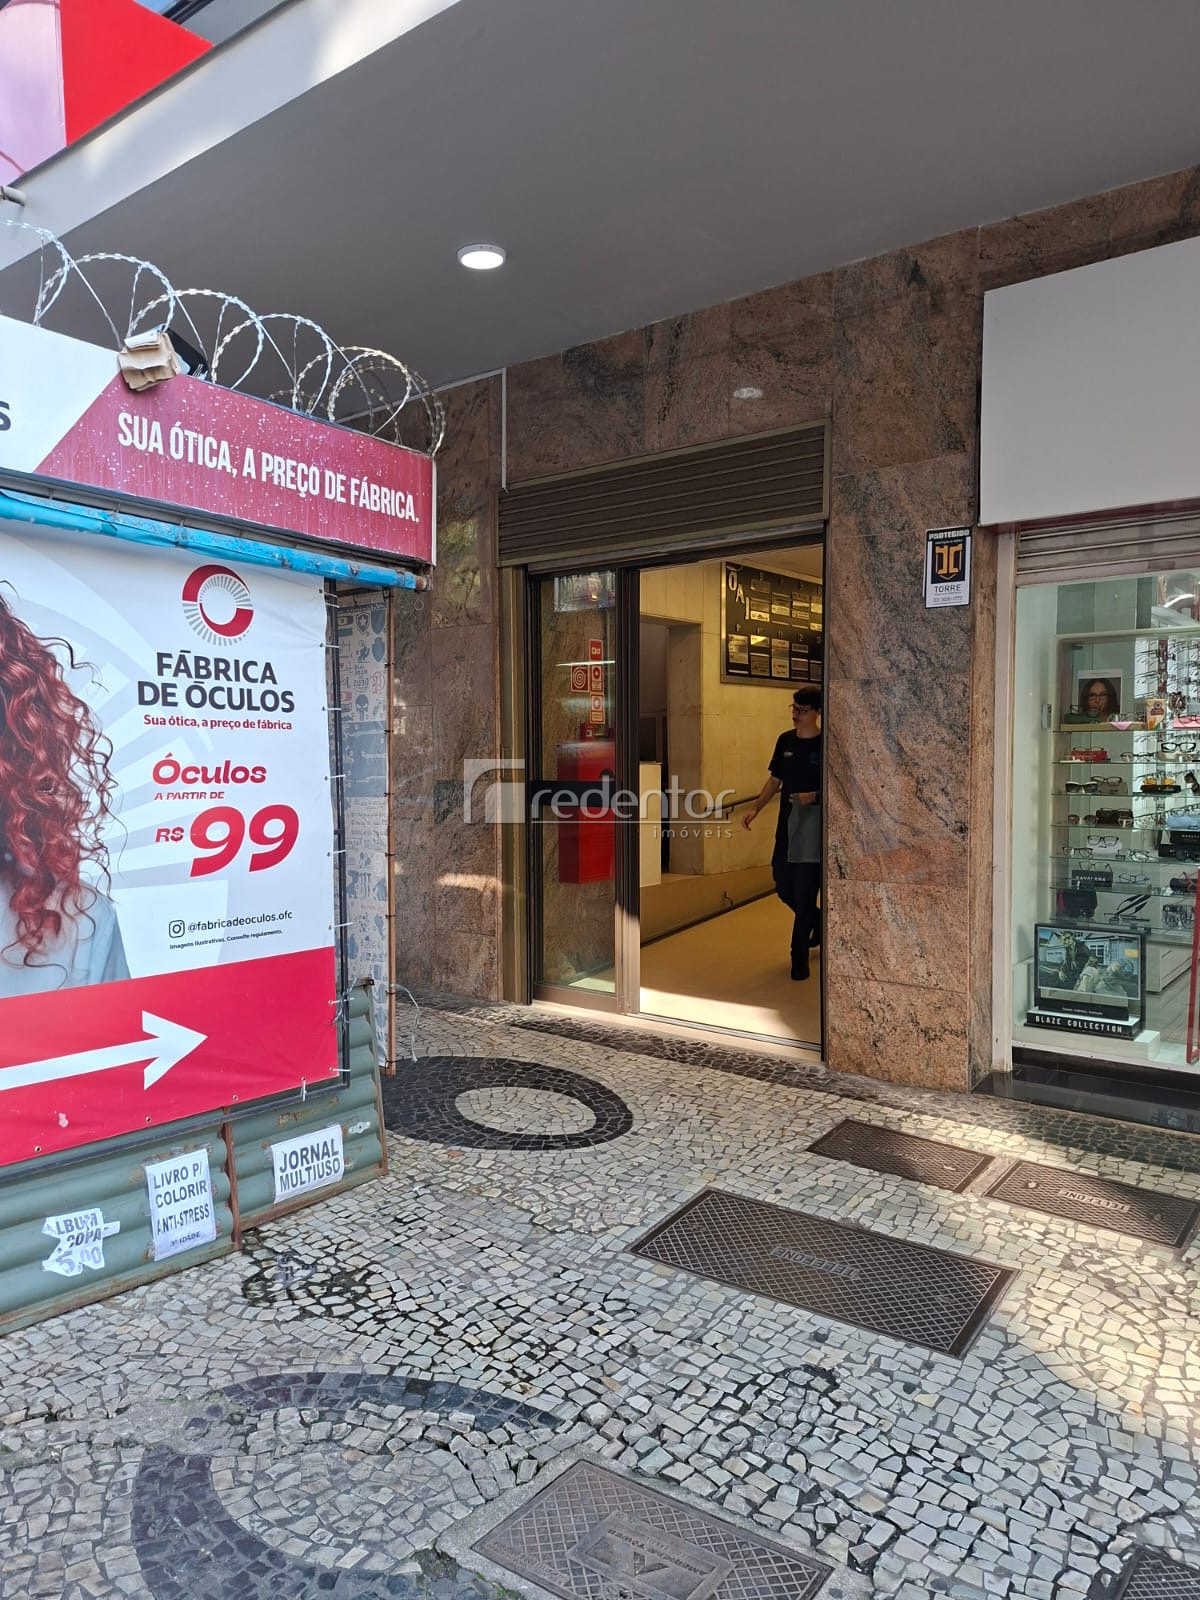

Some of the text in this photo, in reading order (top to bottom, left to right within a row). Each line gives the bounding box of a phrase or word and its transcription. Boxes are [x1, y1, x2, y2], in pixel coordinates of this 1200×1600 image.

[118, 412, 419, 523] SUA ÓTICA, A PREÇO DE FÁBRICA.
[934, 584, 961, 593] TORRE
[137, 680, 179, 707] DE
[143, 714, 292, 730] Sua ótica, a preço de fábrica
[152, 752, 267, 785] Óculos
[154, 791, 225, 800] A PARTIR DE
[155, 826, 185, 843] R$
[190, 804, 299, 877] 99
[188, 910, 293, 932] @fabricadeoculos.ofc
[170, 942, 194, 950] Imagens
[1035, 1015, 1122, 1033] BLAZE COLLECTION
[279, 1138, 339, 1173] JORNAL
[153, 1162, 203, 1189] LIVRO P/
[280, 1157, 341, 1192] MULTIUSO
[155, 1180, 208, 1208] COLORIR
[157, 1203, 210, 1235] ANTI-STRESS
[773, 1247, 855, 1278] TELEFONE
